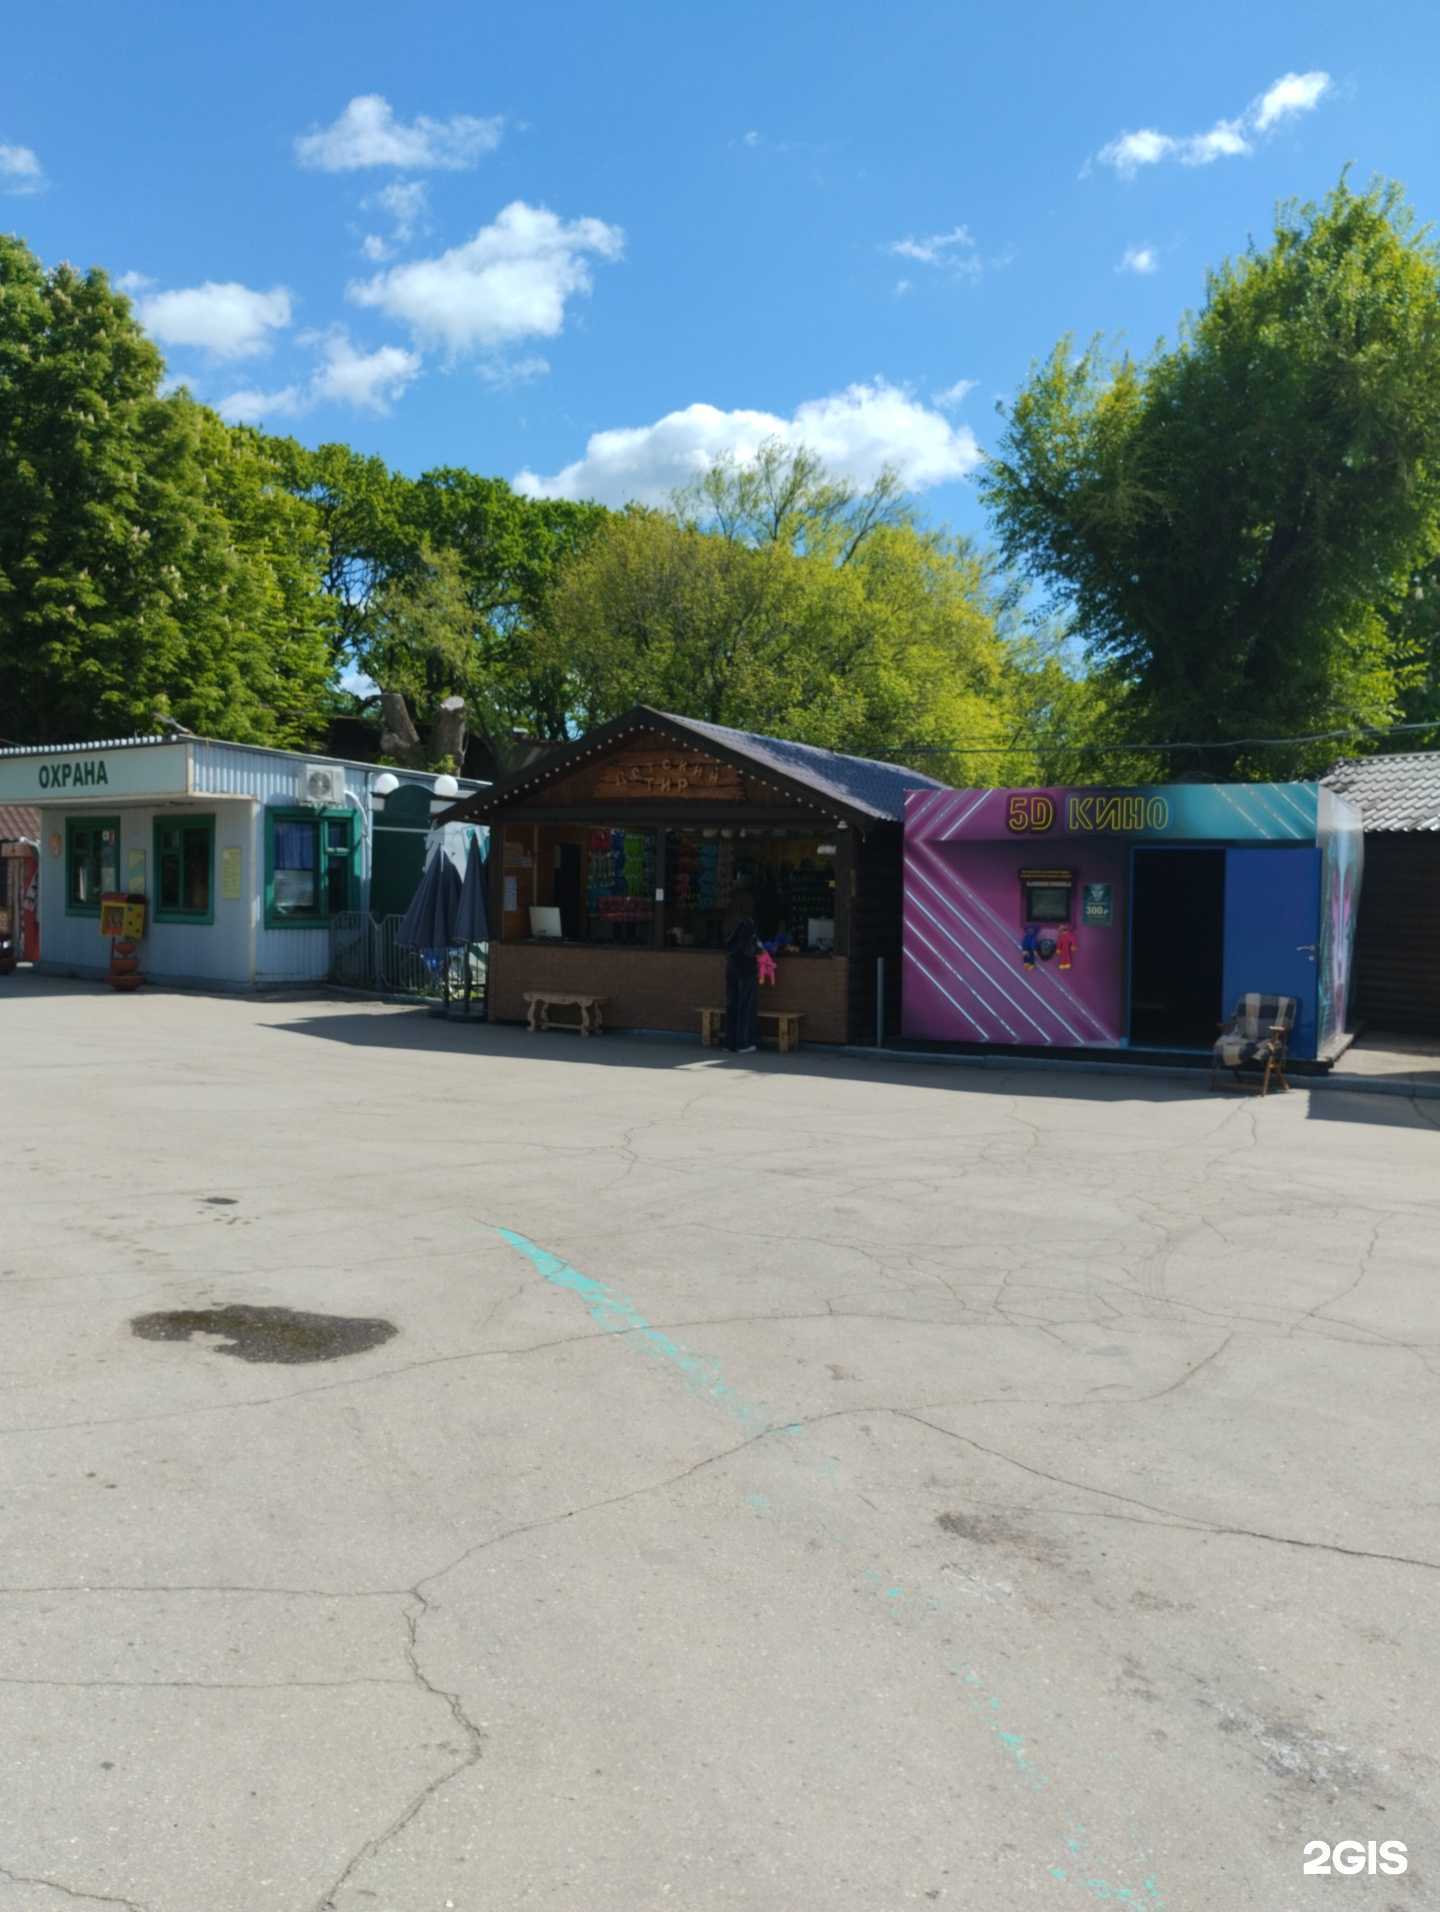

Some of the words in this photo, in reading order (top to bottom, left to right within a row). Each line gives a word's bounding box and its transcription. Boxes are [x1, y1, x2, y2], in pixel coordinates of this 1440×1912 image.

[39, 760, 108, 788] ОХРАНА
[646, 777, 689, 792] ТИР
[1008, 796, 1054, 831] 5D
[1069, 796, 1169, 831] КИНО
